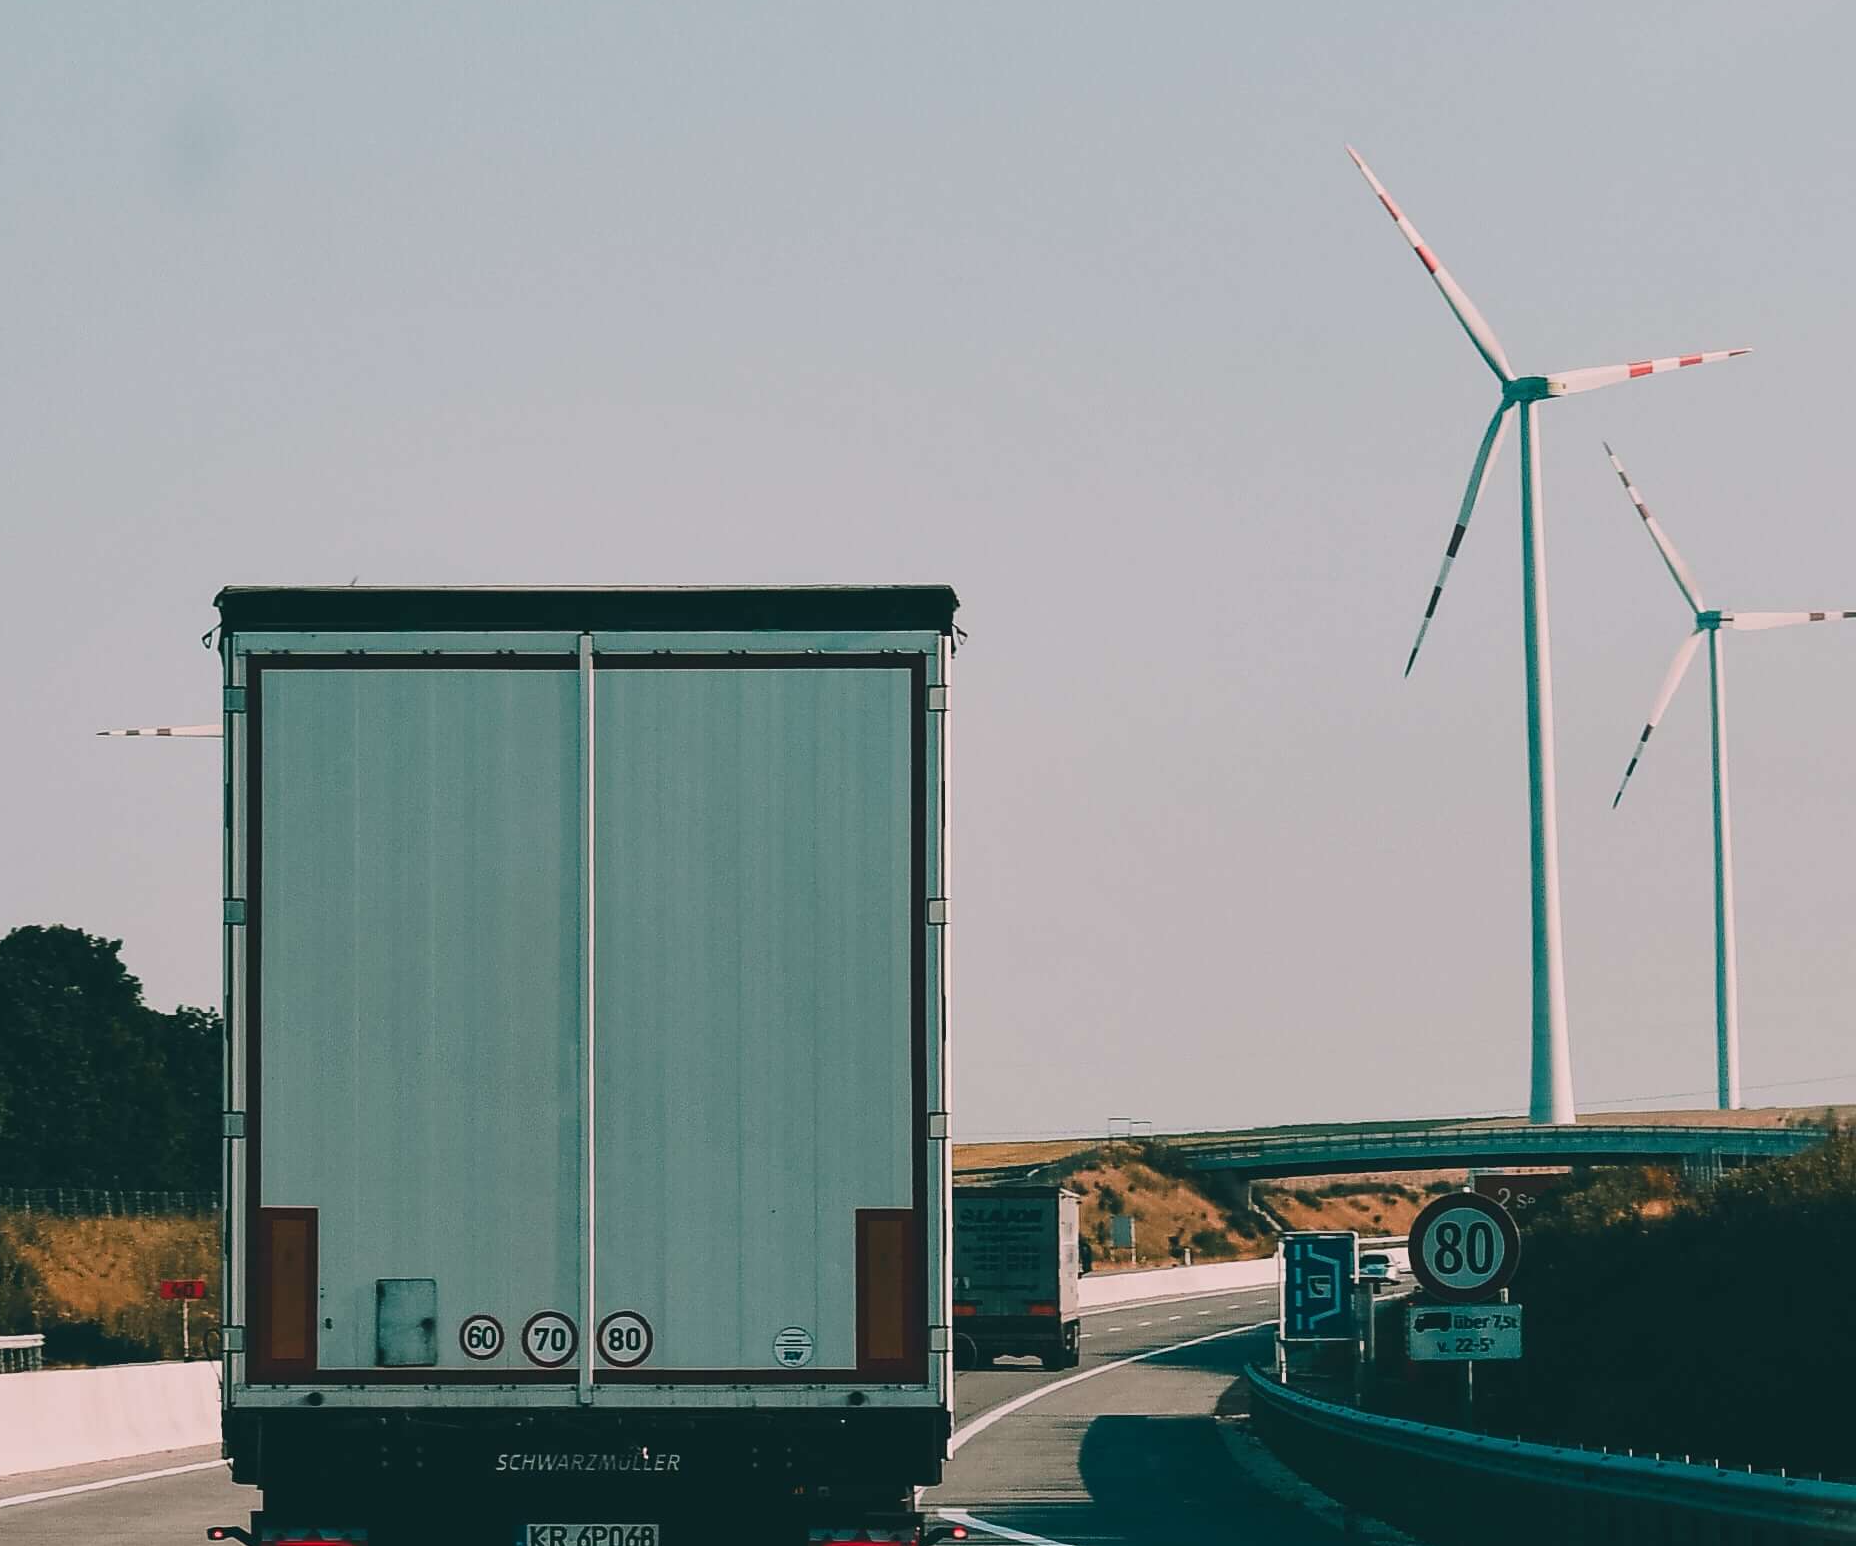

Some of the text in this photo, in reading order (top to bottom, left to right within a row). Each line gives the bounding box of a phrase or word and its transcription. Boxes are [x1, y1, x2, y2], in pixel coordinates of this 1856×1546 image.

[1497, 1187, 1511, 1209] 2
[1433, 1221, 1495, 1275] 80
[1453, 1315, 1490, 1330] über
[467, 1325, 496, 1350] 60
[533, 1327, 566, 1352] 70
[608, 1327, 641, 1352] 80
[495, 1453, 681, 1471] SCHWARZMÜLLER
